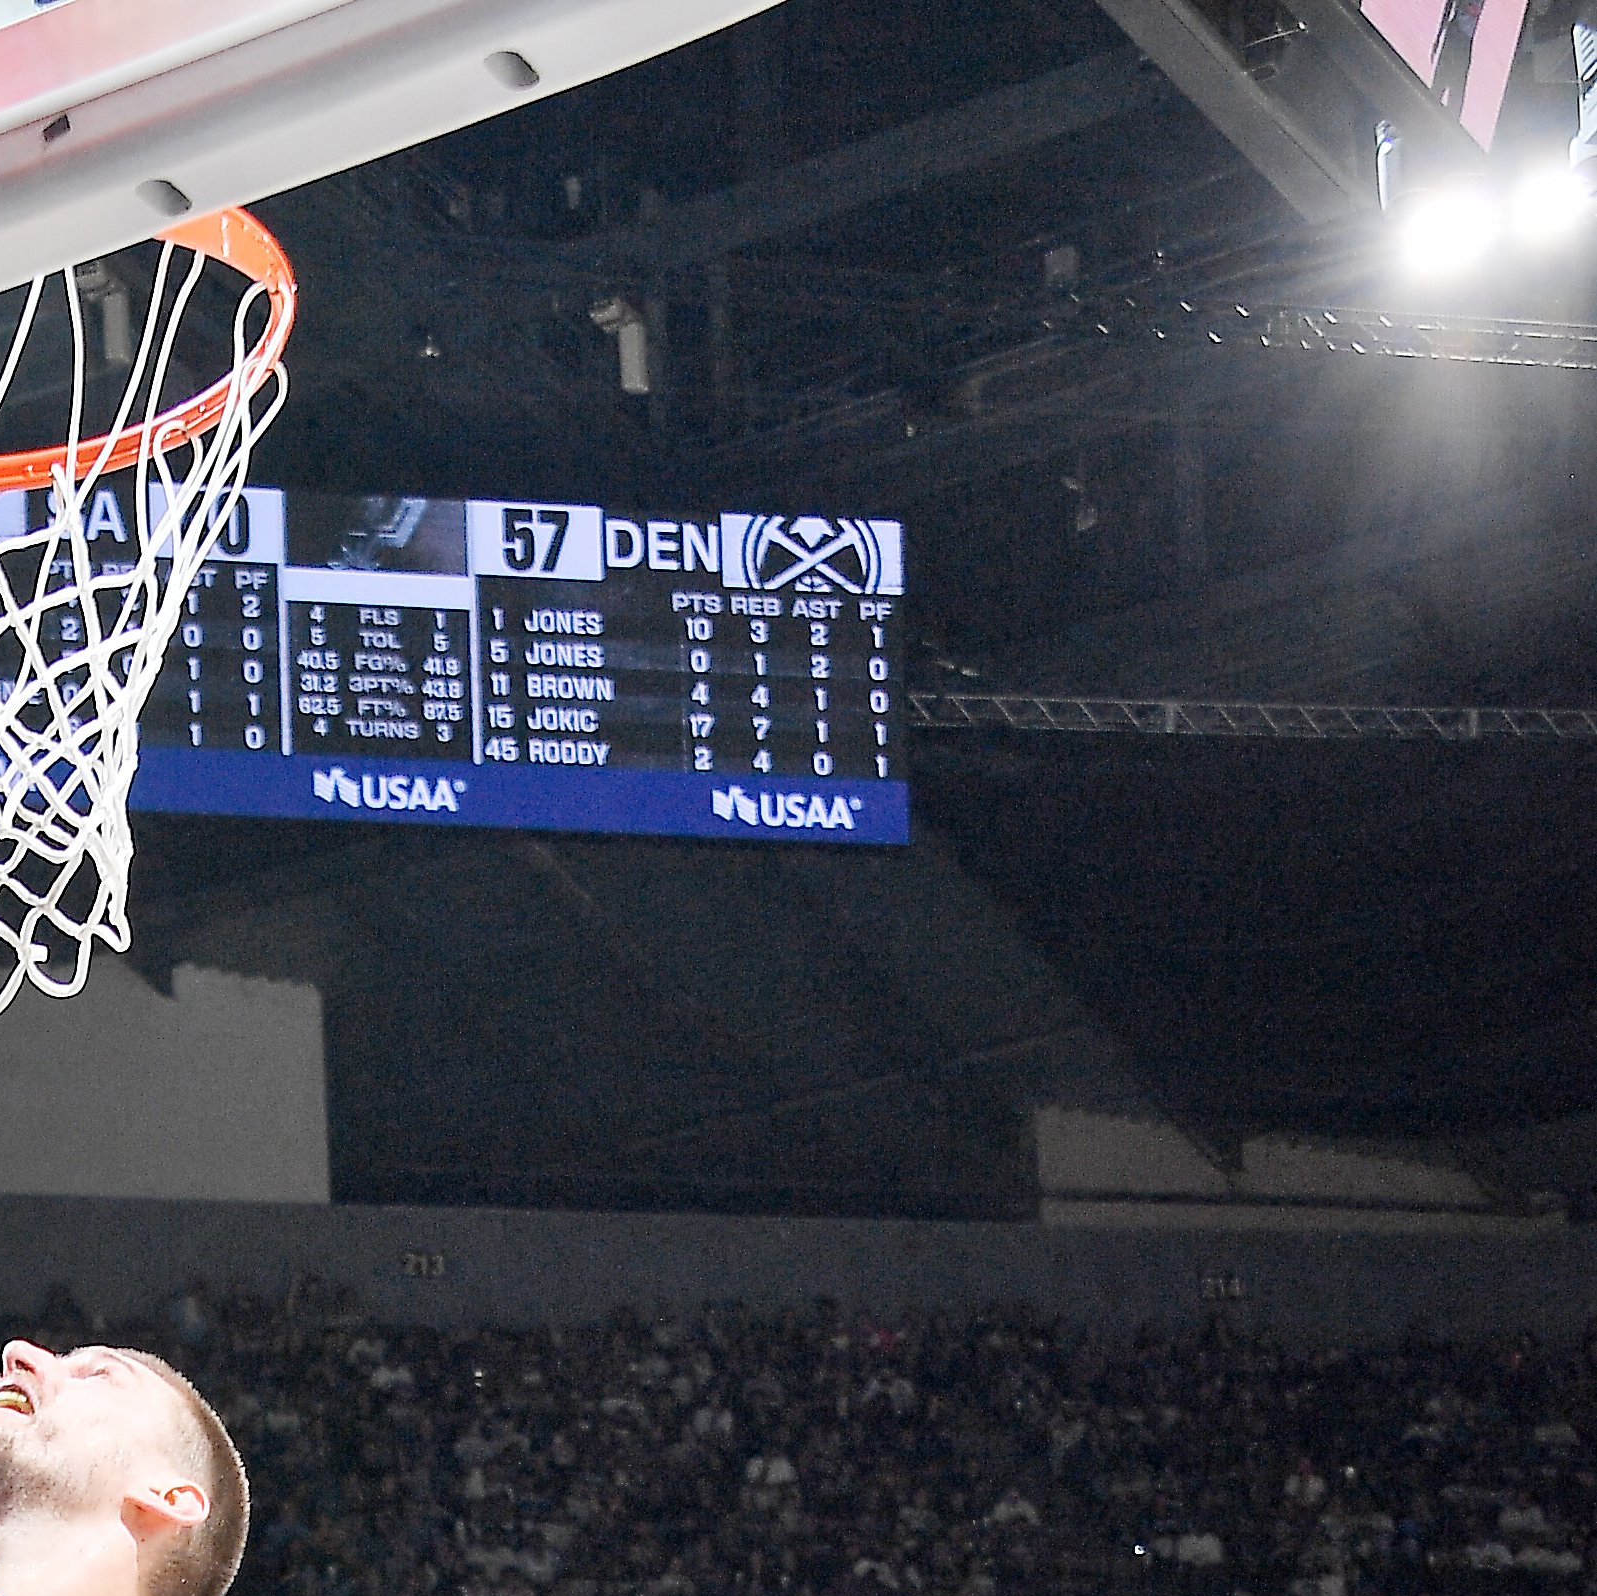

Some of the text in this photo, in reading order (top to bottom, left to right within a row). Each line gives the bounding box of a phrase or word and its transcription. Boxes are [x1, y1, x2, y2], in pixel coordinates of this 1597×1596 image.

[502, 507, 569, 573] 57
[604, 517, 720, 574] DEN
[233, 568, 269, 590] PF
[242, 594, 262, 618] 2
[309, 604, 326, 622] 4
[671, 591, 892, 622] PTS REB AST PF
[182, 623, 204, 648] 0
[241, 626, 263, 651] 0
[433, 632, 450, 652] 5
[492, 607, 885, 649] 1 JONES 10 3 2 1
[187, 656, 264, 684] 1 0
[489, 638, 889, 682] 5 JONES 0 1 2 0
[188, 689, 202, 714] 1
[248, 692, 261, 717] 1
[489, 672, 890, 714] 11 BROWN 4 4 1 0
[189, 722, 203, 747] 1
[244, 723, 266, 750] 0
[312, 716, 452, 743] 4 TURNS 3
[487, 703, 888, 747] 15 JOKIC 17 7 1 1
[484, 737, 520, 762] 45
[693, 745, 714, 771] 2
[752, 748, 773, 774] 4
[813, 750, 834, 777] 0
[875, 753, 889, 778] 1
